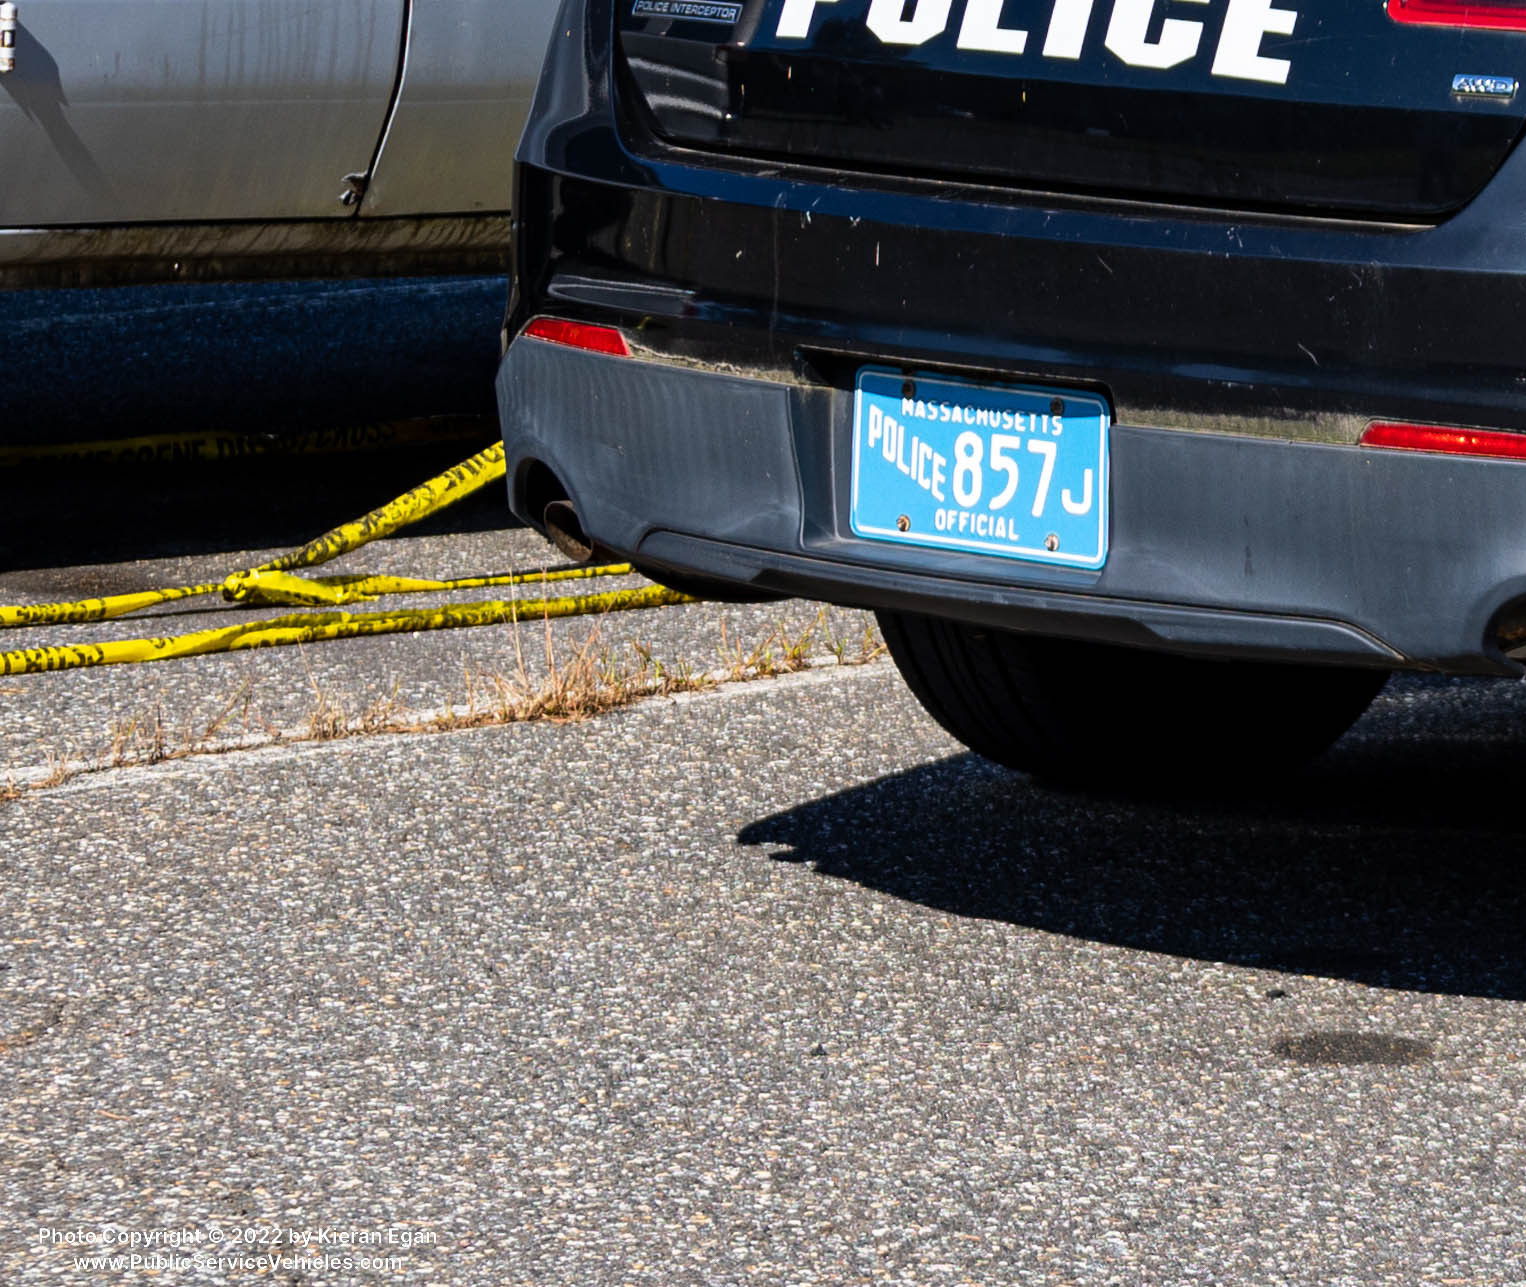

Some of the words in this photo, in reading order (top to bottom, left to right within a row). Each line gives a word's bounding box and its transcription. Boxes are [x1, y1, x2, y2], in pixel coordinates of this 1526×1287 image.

[637, 0, 668, 13] POLICE
[670, 2, 738, 21] INTERCEPTOR
[901, 396, 1064, 437] MASSACHUSETTS
[868, 403, 947, 503] POLICE
[934, 508, 1019, 541] OFFICIAL
